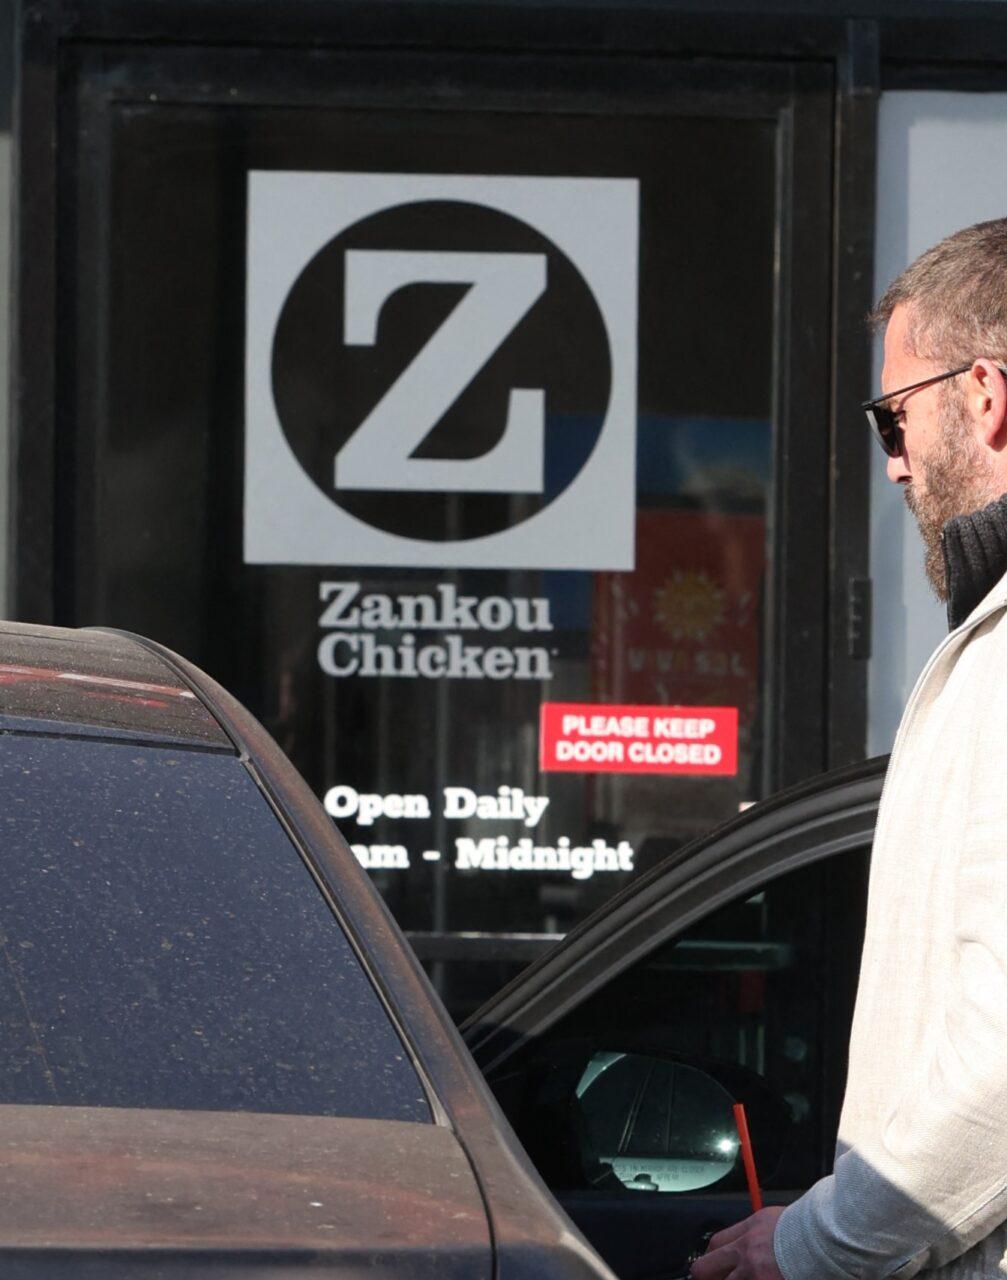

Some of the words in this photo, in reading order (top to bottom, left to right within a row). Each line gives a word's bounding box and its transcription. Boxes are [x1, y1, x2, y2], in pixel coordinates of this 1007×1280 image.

[334, 249, 548, 494] Z
[318, 581, 554, 631] Zankou
[317, 632, 554, 680] Chicken
[562, 714, 649, 738] PLEASE
[653, 717, 716, 740] KEEP
[555, 741, 624, 763] DOOR
[628, 743, 722, 766] CLOSED
[324, 785, 430, 826] Open
[444, 786, 549, 827] Daily
[349, 844, 410, 869] am
[455, 836, 634, 880] Midnight
